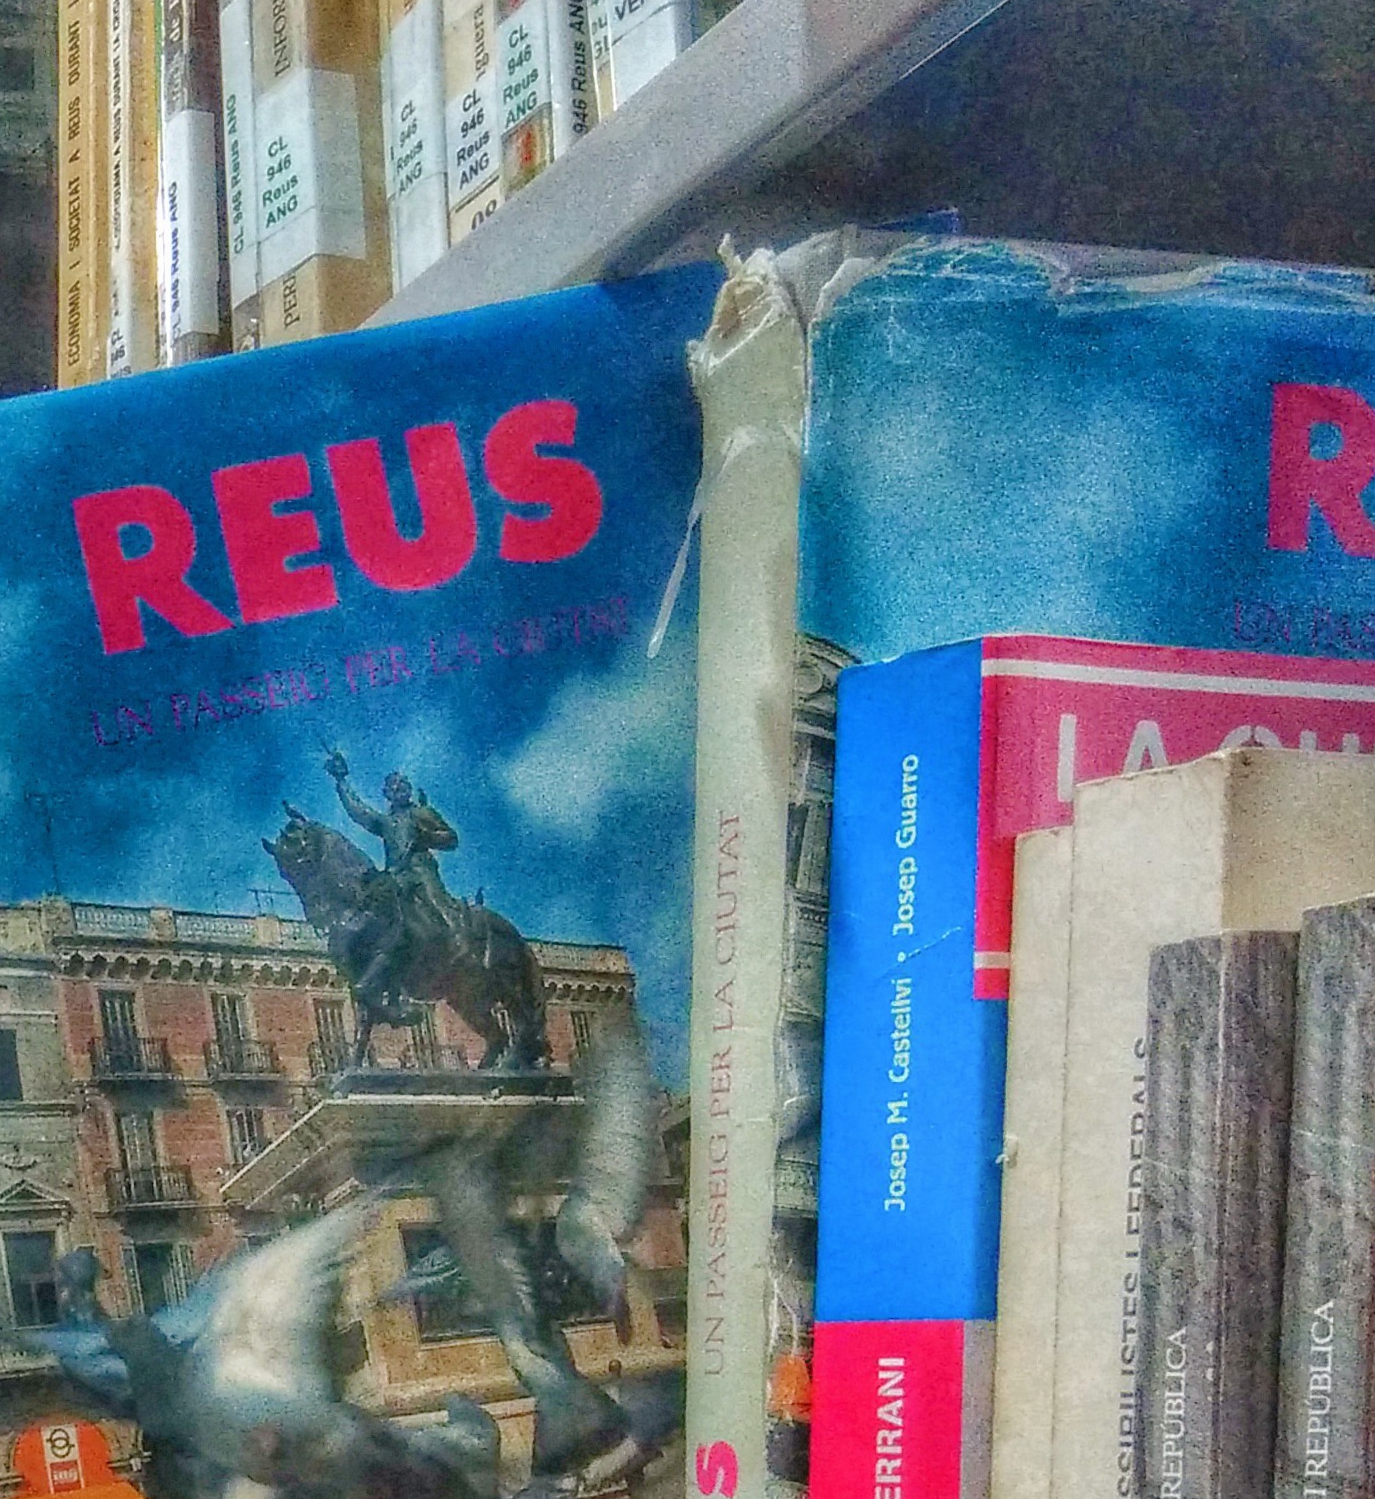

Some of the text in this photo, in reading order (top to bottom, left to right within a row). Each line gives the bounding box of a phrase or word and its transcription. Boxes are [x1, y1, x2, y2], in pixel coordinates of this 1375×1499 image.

[65, 20, 81, 83] DURANT
[508, 23, 529, 49] CL
[507, 45, 532, 76] 946
[462, 88, 482, 112] CL
[502, 68, 539, 104] Reus
[571, 41, 587, 136] 946 Reus
[65, 96, 81, 137] REUS
[400, 100, 416, 122] CL
[460, 107, 484, 139] 946
[505, 90, 538, 128] ANG
[267, 135, 288, 158] CL
[399, 120, 418, 149] 946
[456, 131, 490, 167] Reus
[66, 148, 81, 162] A
[227, 93, 245, 254] CL 946 Reus ANG
[266, 154, 292, 182] 946
[396, 140, 423, 176] Reus
[459, 152, 490, 190] ANG
[261, 174, 299, 208] Reus
[398, 161, 422, 197] ANG
[66, 175, 81, 249] SOCIETAT
[168, 181, 179, 223] ANG
[265, 195, 299, 229] ANG
[169, 227, 180, 276] Reus
[170, 278, 180, 313] 946
[66, 280, 81, 366] ECONOMIA
[73, 400, 603, 655] REUS
[91, 706, 155, 748] UN
[167, 661, 333, 733] PASSEIG
[344, 643, 415, 696] PER
[429, 630, 482, 675] LA
[714, 810, 744, 968] CIUTAT
[884, 752, 921, 1213] Josep M. Josep Guarro
[711, 979, 739, 1035] LA
[708, 1056, 735, 1119] PER
[706, 1132, 733, 1300] PASSEIG
[704, 1316, 726, 1375] UN
[1303, 1300, 1335, 1478] REPÚBLICA
[1159, 1326, 1188, 1497] REPÚBLICA
